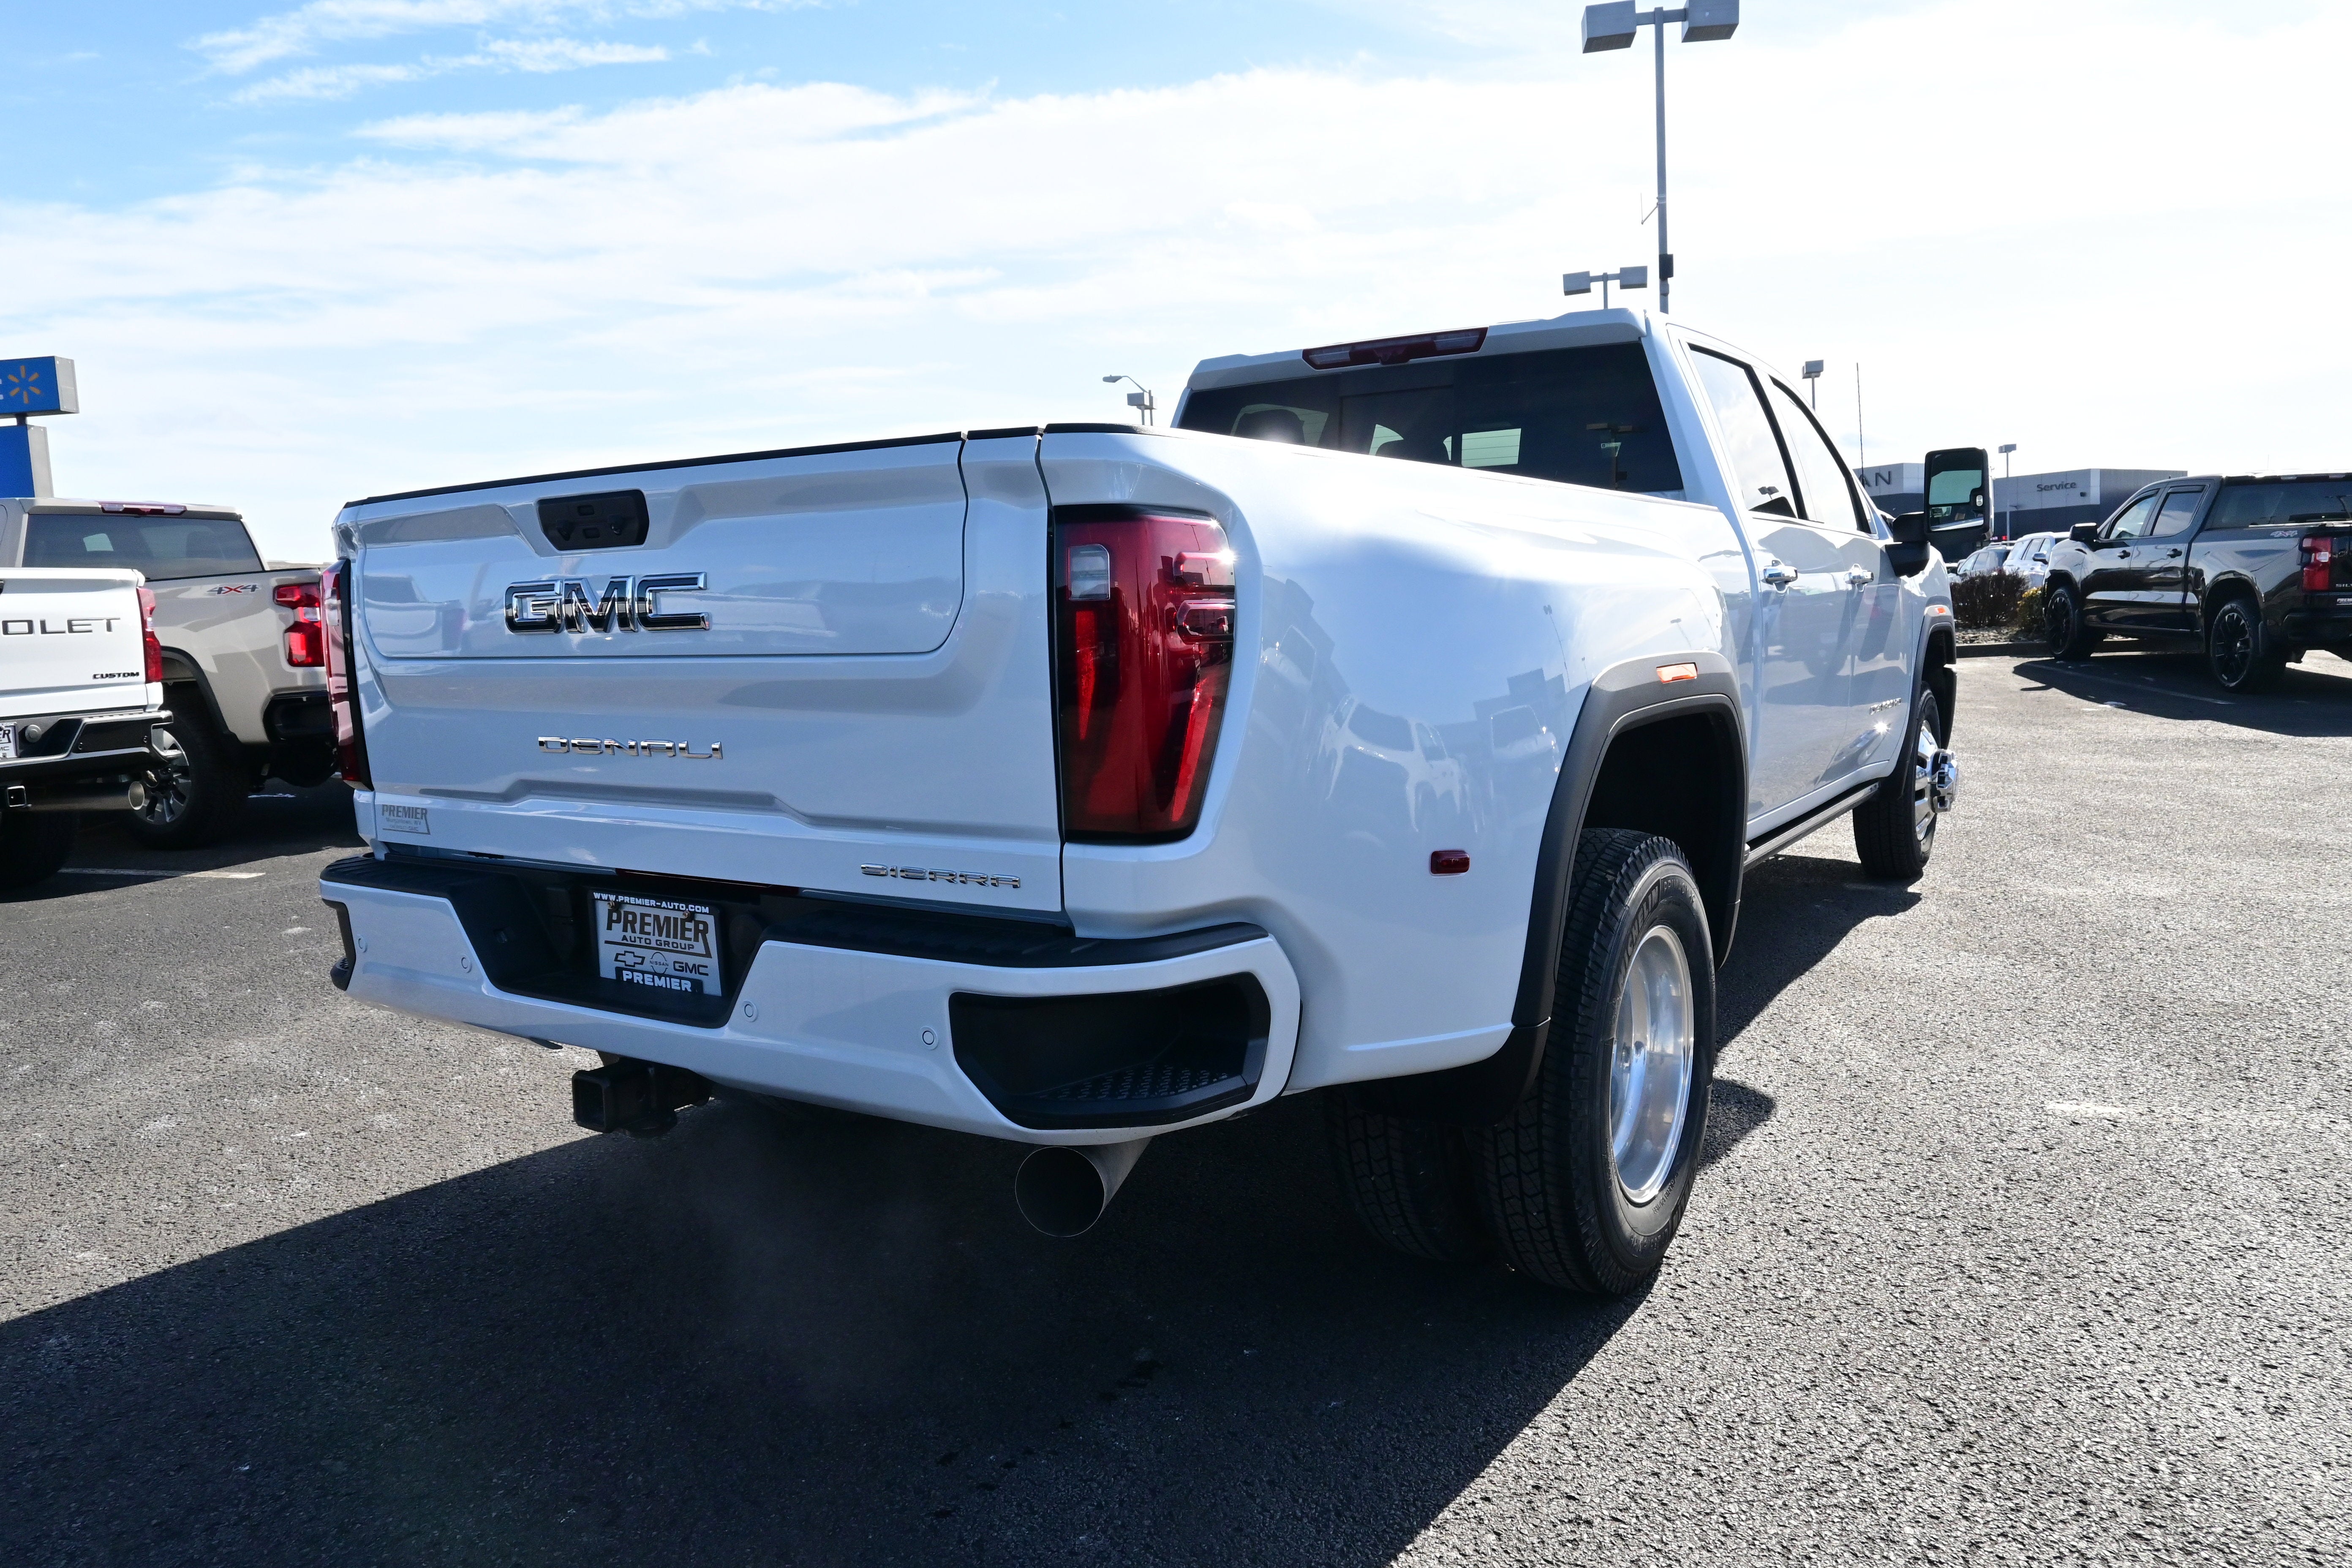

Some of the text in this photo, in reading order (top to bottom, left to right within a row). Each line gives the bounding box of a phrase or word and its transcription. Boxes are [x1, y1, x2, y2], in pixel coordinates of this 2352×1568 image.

[2037, 482, 2077, 491] Service
[505, 572, 710, 633] GMC
[2, 618, 120, 634] OLET
[538, 736, 723, 760] DENALI
[381, 804, 428, 822] PREMIER
[860, 863, 1021, 888] SIERRA
[593, 892, 709, 913] WWW.PREMIER-AUTO.COM
[606, 909, 710, 946] PREMIER
[621, 935, 694, 950] AUTO GROUP
[673, 961, 709, 976] GMC
[622, 970, 692, 992] PREMIER
